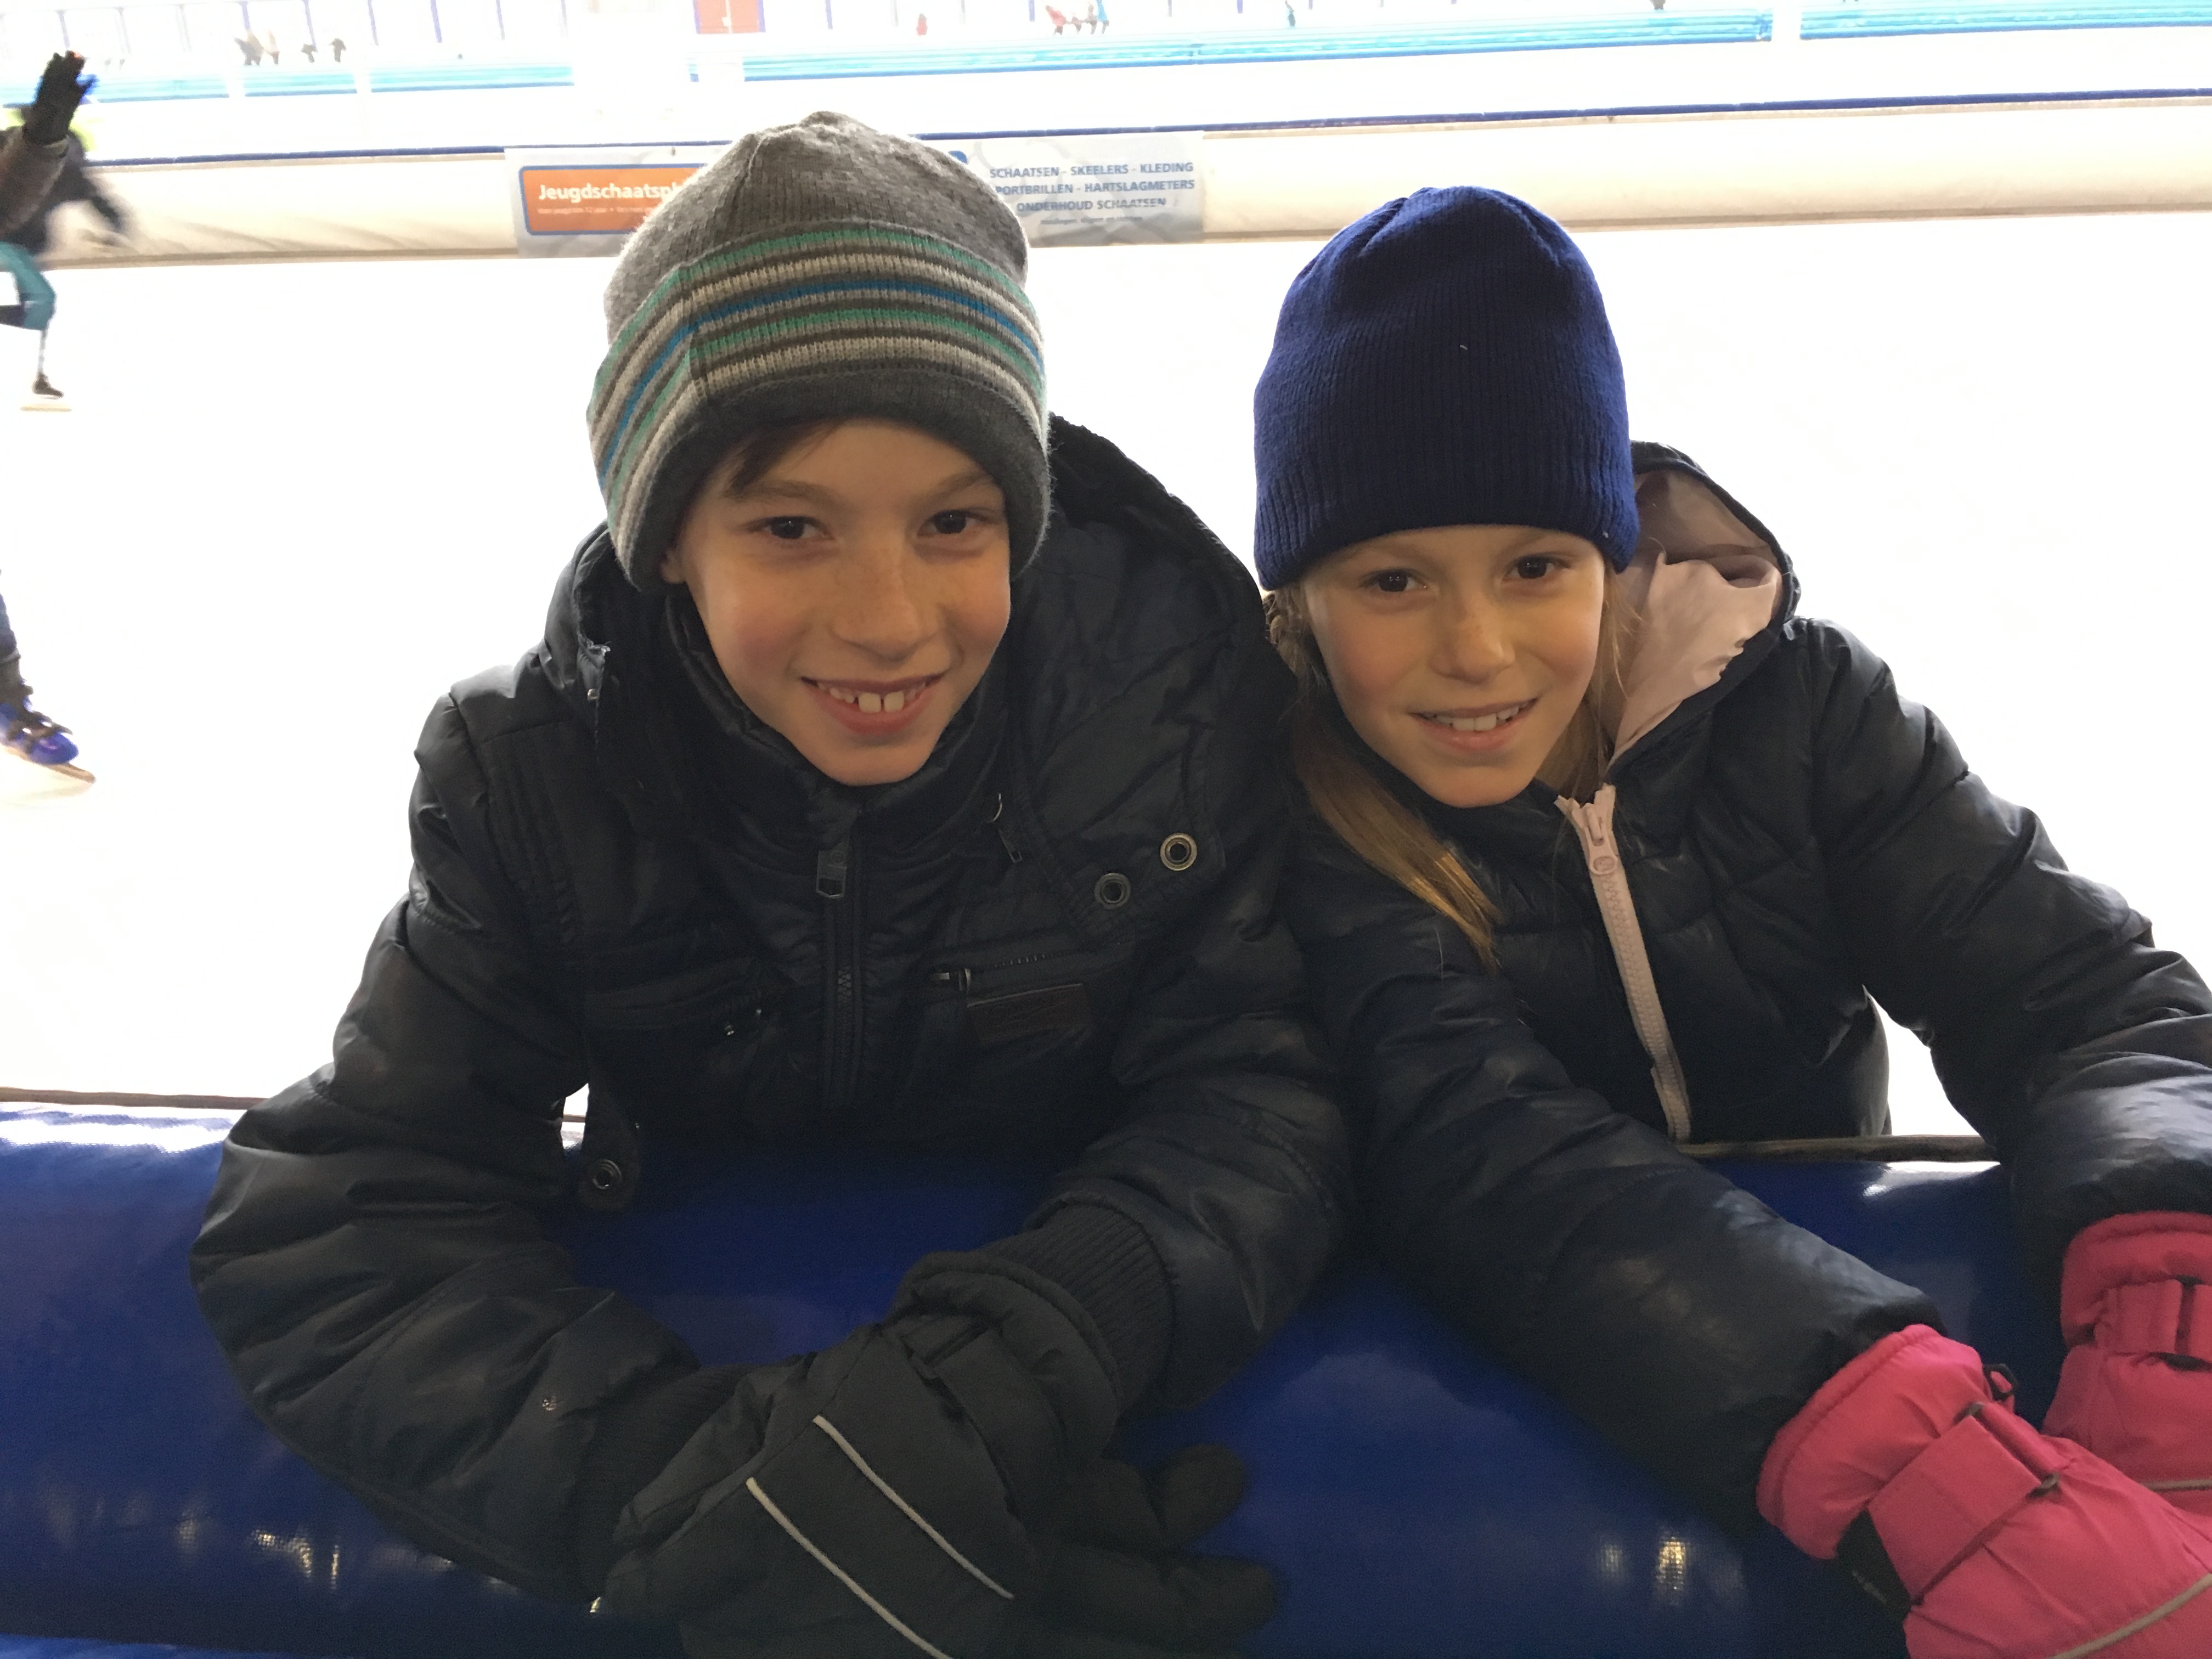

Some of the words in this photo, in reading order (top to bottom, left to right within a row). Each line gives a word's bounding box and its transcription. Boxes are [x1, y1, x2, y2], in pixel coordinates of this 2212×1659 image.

[990, 167, 1060, 178] SCHAATSEN
[1070, 165, 1129, 176] SKEELERS
[1139, 162, 1194, 173] KLEDING
[539, 182, 684, 204] Jeugdschaatspl
[995, 184, 1074, 195] PORTBRILLEN
[1084, 179, 1195, 192] HARTSLAGMETERS
[1016, 200, 1093, 212] ONDERHOUD
[1097, 198, 1167, 210] SCHAATSEN
